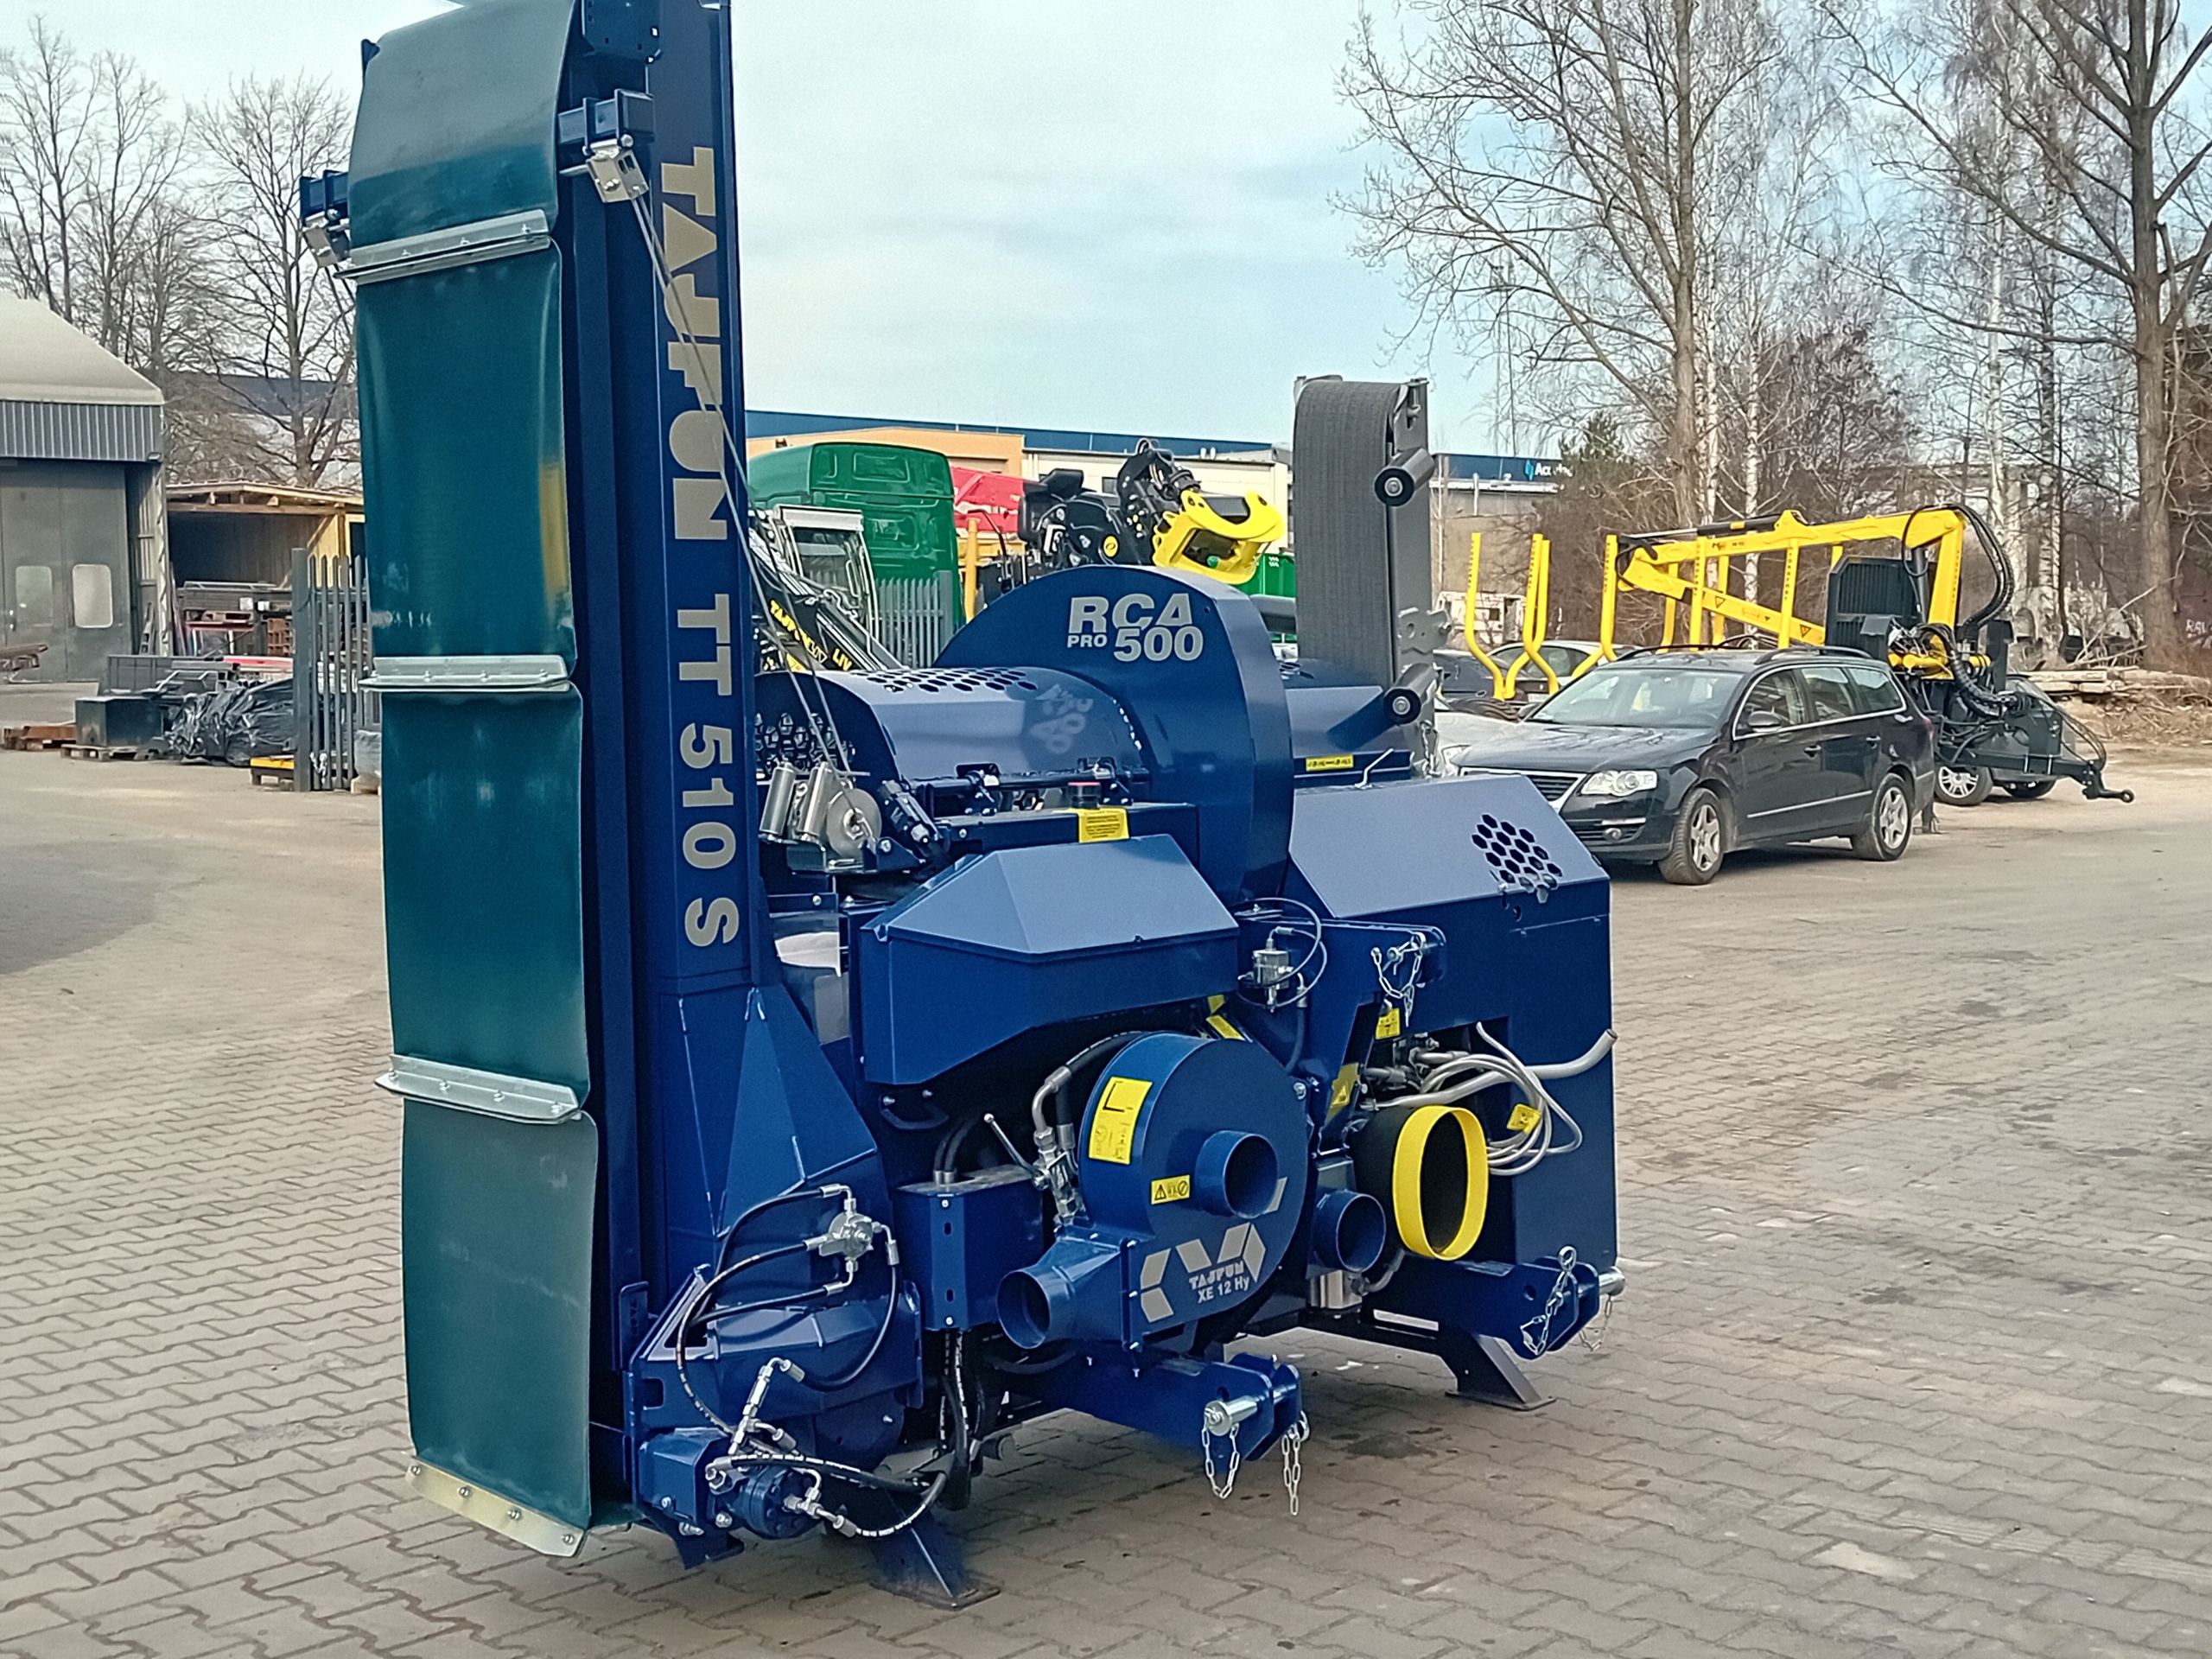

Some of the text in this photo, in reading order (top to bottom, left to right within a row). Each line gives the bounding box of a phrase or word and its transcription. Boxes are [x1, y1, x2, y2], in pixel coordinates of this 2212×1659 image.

[661, 146, 739, 947] TAJFUN TT 510 S
[1069, 593, 1193, 633] RCA
[1067, 634, 1108, 648] PRO
[1114, 626, 1204, 661] 500
[1189, 1260, 1244, 1290] TAJFUN
[1198, 1275, 1249, 1304] XE 12 Hy
